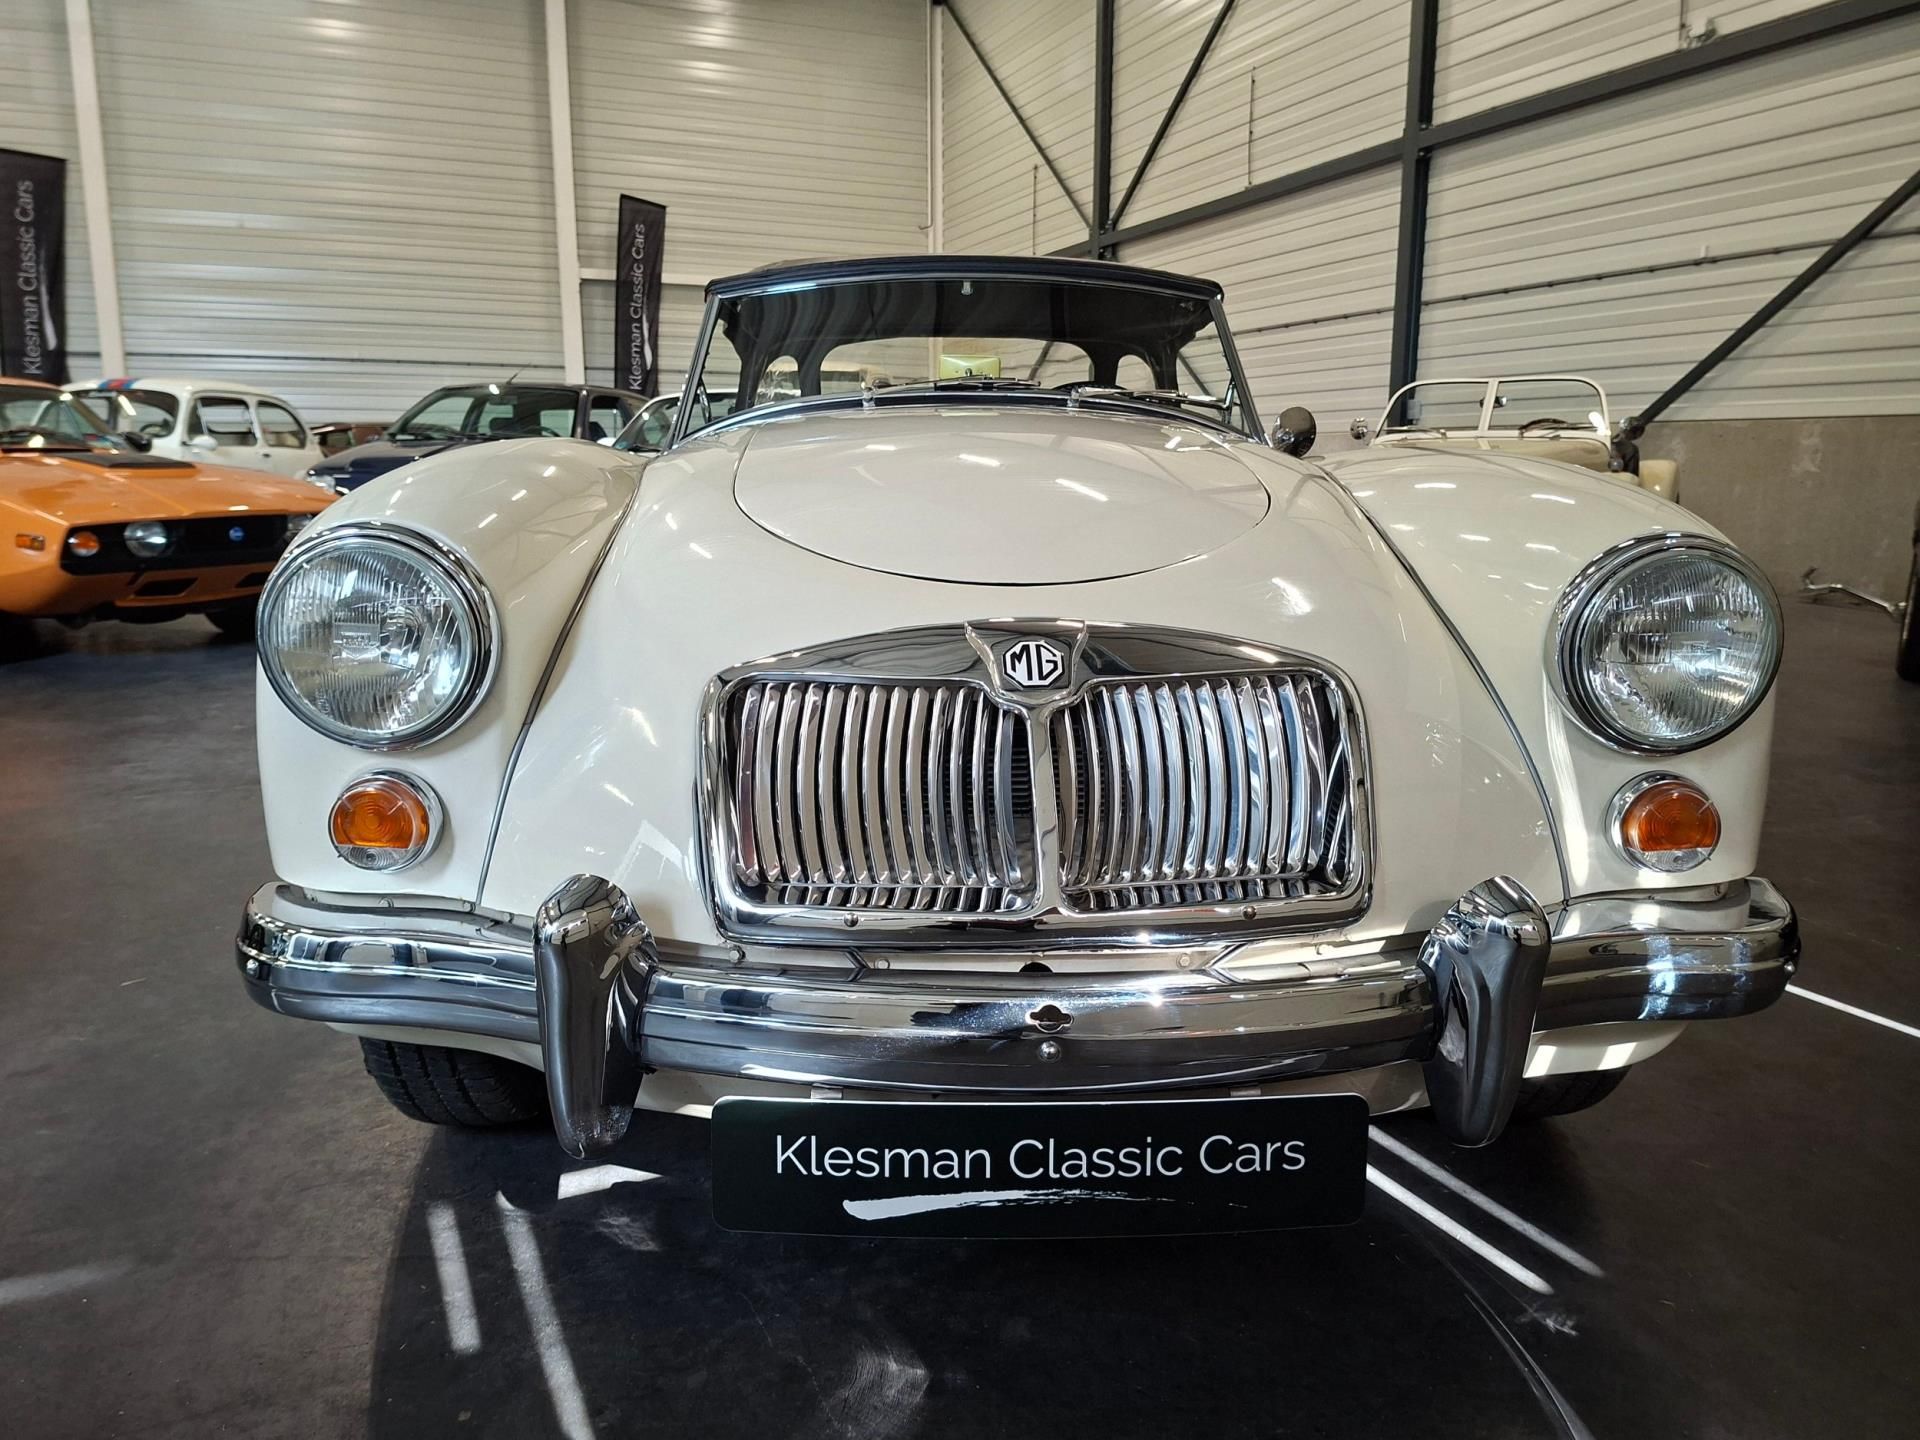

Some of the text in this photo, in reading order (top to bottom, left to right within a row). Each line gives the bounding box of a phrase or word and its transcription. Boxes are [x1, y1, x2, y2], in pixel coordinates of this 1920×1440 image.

[15, 179, 42, 374] Klesman Classic Cars
[629, 223, 646, 390] Klesman Classic Cars
[1009, 643, 1059, 681] MG
[776, 1134, 1306, 1179] Klesman Classic Cars
